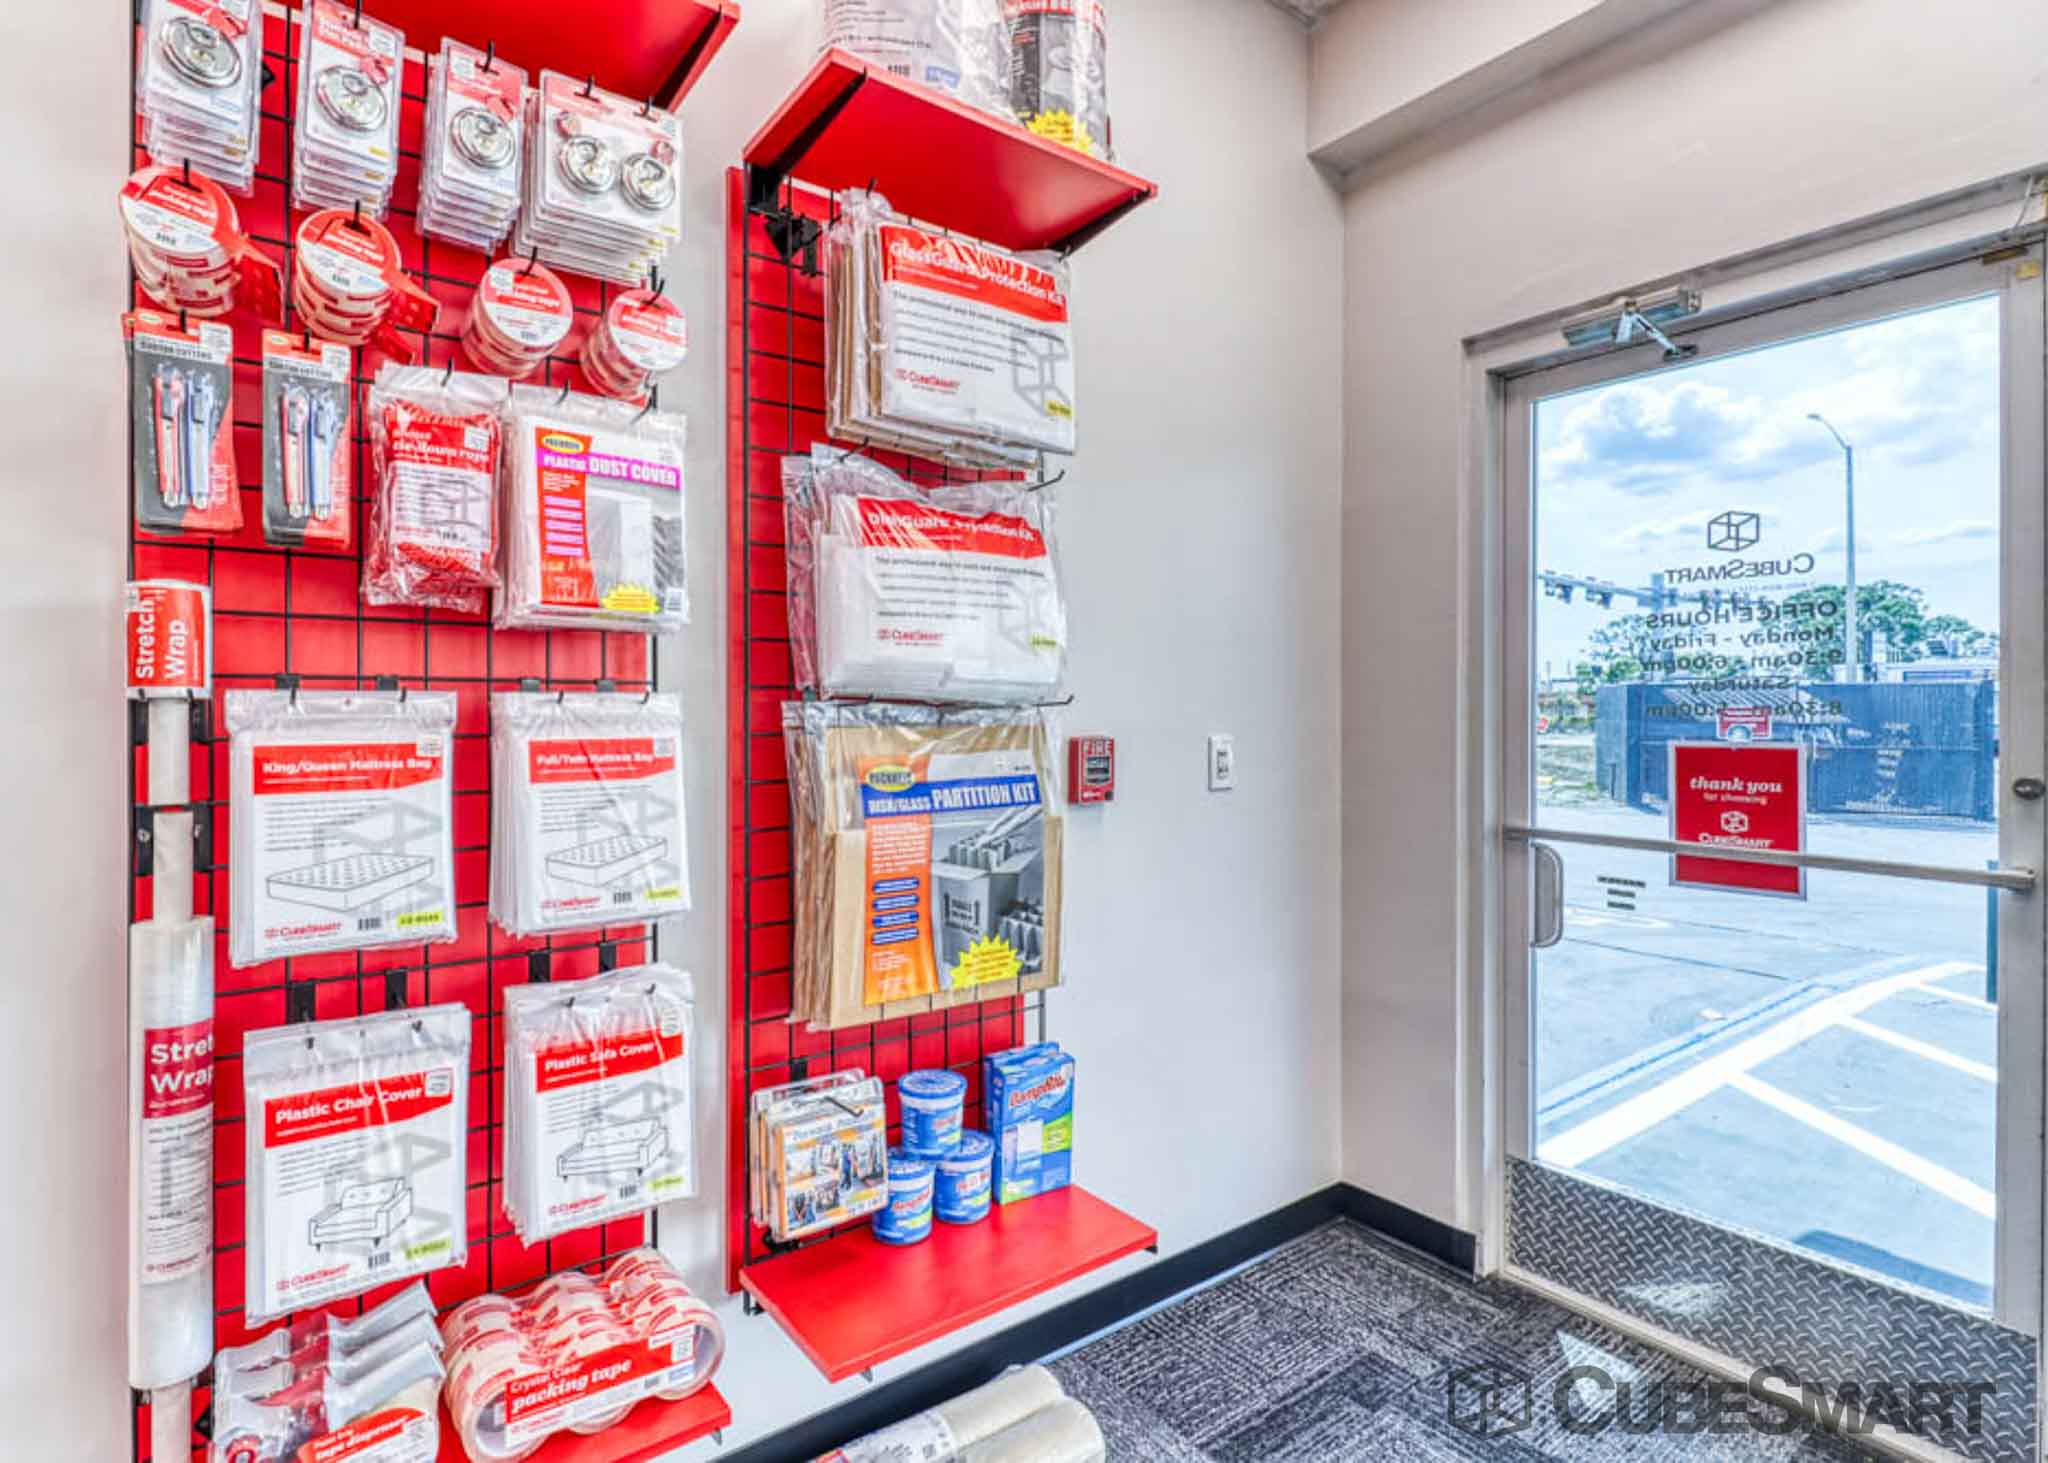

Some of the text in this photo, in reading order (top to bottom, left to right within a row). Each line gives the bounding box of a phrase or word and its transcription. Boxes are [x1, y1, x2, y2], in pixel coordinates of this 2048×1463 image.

[589, 456, 629, 478] DUST
[631, 463, 676, 486] COVER
[164, 619, 188, 680] Wrap
[263, 760, 347, 775] King/Queen
[407, 758, 432, 771] Bag
[932, 784, 1010, 810] PARTITION
[1012, 782, 1036, 802] KIT
[1689, 776, 1782, 796] thank you
[545, 1055, 587, 1072] Plastic
[620, 1042, 656, 1057] Cover
[275, 1087, 424, 1125] Plastic Chair Cover
[512, 1359, 633, 1414] packing tape
